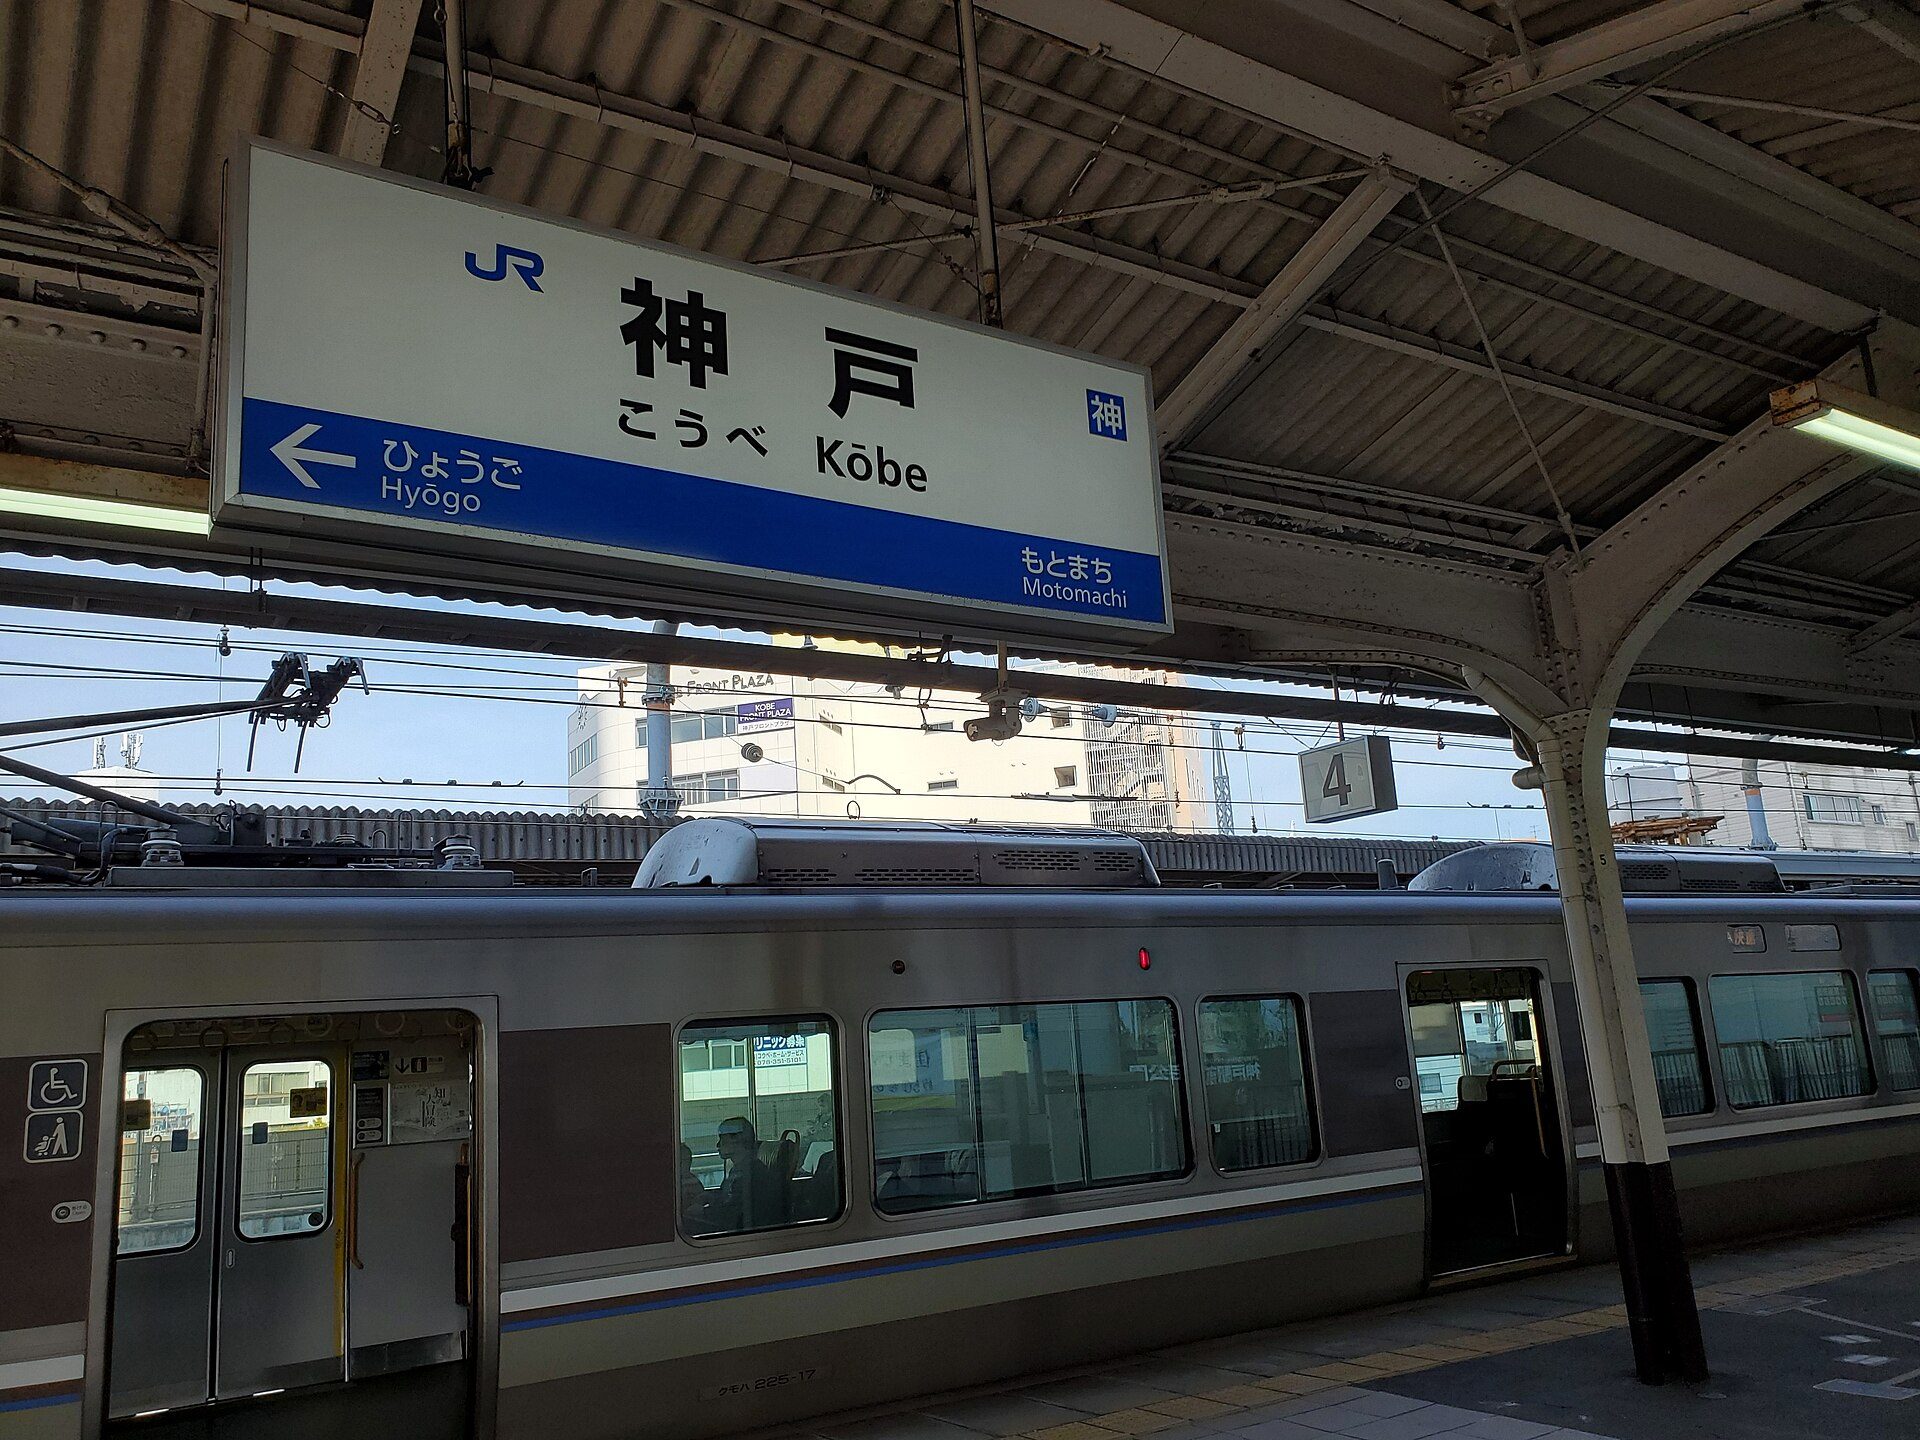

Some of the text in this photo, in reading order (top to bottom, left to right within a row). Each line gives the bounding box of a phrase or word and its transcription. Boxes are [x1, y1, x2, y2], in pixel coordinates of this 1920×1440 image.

[464, 243, 545, 294] JR
[620, 276, 918, 420] 神戸
[618, 398, 768, 458] こうべ
[1091, 394, 1123, 436] 神
[382, 438, 524, 491] ひょうご
[816, 435, 928, 493] Kōbe
[381, 476, 482, 516] Hyōgo
[1021, 546, 1112, 584] もとまち
[1023, 576, 1128, 609] Motomachi
[732, 674, 775, 690] PLAZA
[739, 708, 792, 722] FRONT PLAZA
[755, 702, 776, 712] KOBE
[1322, 752, 1352, 806] 4
[1600, 854, 1607, 865] 5
[753, 1035, 805, 1050] リニック募集
[719, 1369, 817, 1396] クモハ 225-17
